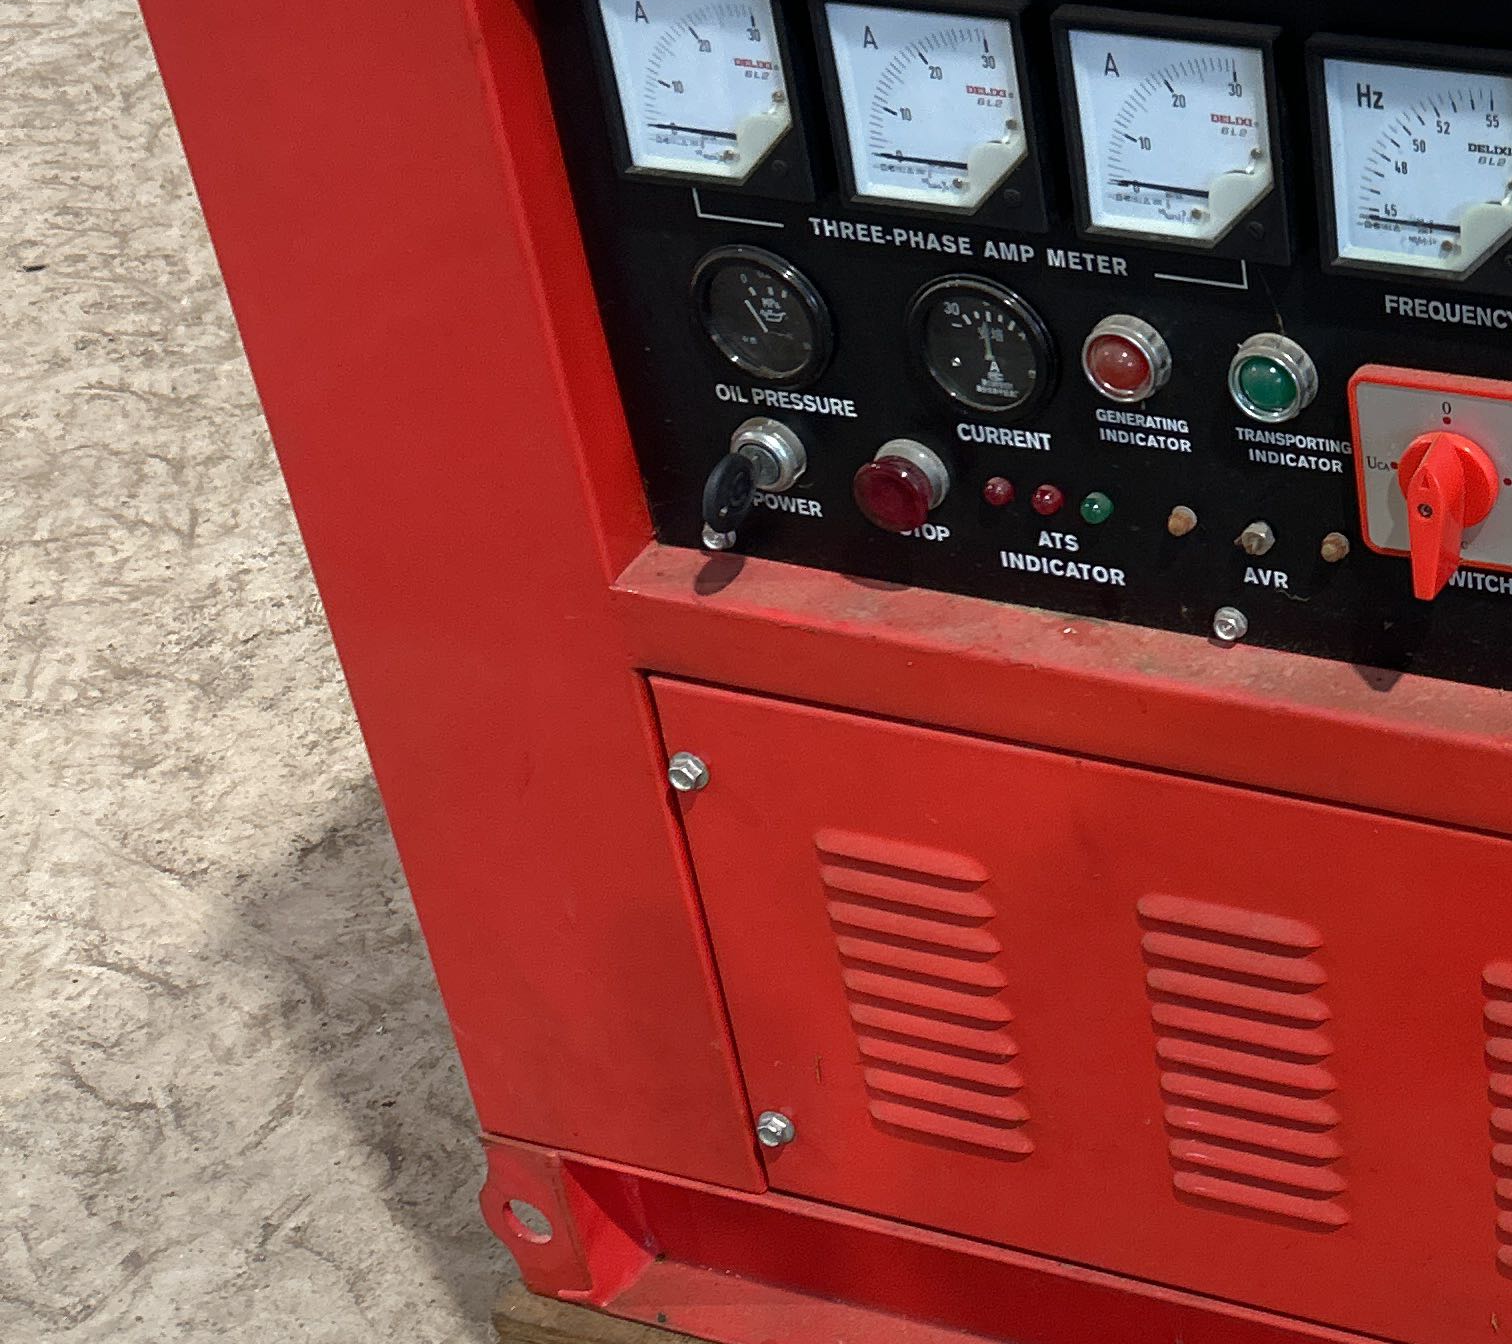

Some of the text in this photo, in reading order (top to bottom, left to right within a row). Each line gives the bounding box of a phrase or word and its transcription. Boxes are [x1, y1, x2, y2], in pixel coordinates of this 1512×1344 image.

[634, 1, 649, 24] A
[747, 28, 761, 42] 30
[864, 26, 879, 50] A
[699, 40, 711, 53] 20
[982, 55, 995, 70] 30
[1104, 53, 1120, 77] A
[929, 66, 942, 80] 20
[672, 80, 684, 94] 10
[1228, 84, 1242, 97] 30
[1172, 94, 1186, 108] 20
[1356, 82, 1384, 110] Hz
[901, 107, 912, 122] 10
[1486, 114, 1499, 129] 55
[1437, 120, 1450, 135] 52
[1140, 137, 1151, 151] 10
[1412, 139, 1426, 153] 50
[1468, 143, 1512, 156] DELIXI
[1395, 161, 1408, 174] 48
[1384, 204, 1397, 216] 45
[809, 217, 1128, 276] THREE-PHASE AMP METER
[944, 301, 960, 315] 30
[715, 384, 857, 418] OIL PRESSURE
[1096, 409, 1189, 434] GENERATING
[957, 423, 1051, 451] CURRENT
[1100, 429, 1192, 453] INDICATOR
[1236, 427, 1352, 455] TRANSPORTING
[1249, 448, 1342, 473] INDICATOR
[900, 523, 951, 542] OP
[1038, 531, 1079, 552] ATS
[1001, 551, 1125, 586] INDICATOR
[1243, 566, 1289, 590] AVR
